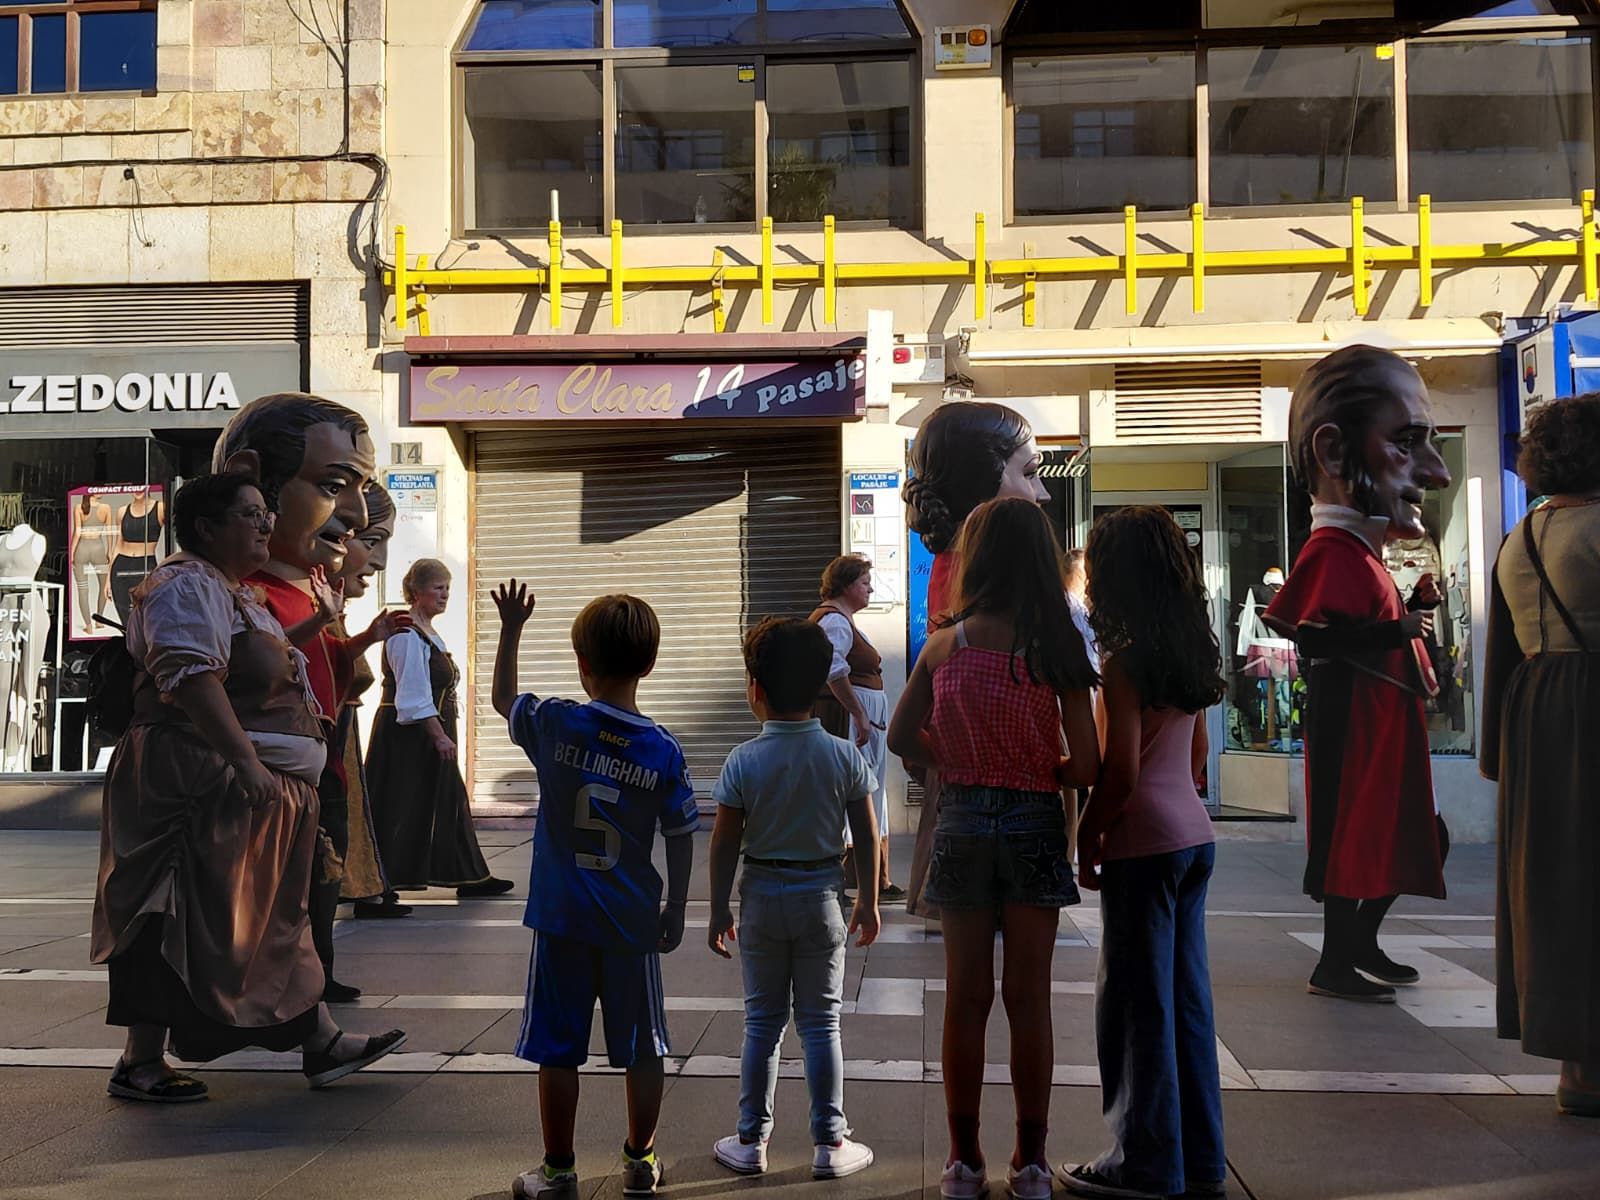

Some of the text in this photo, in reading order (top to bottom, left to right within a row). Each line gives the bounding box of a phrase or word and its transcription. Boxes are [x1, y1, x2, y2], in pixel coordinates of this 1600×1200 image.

[418, 363, 744, 414] Santa Clara 14
[756, 359, 865, 413] Pasaje
[396, 443, 421, 464] 14
[597, 730, 633, 749] RMCF
[553, 741, 659, 792] BELLINGHAM
[574, 783, 622, 872] 5
